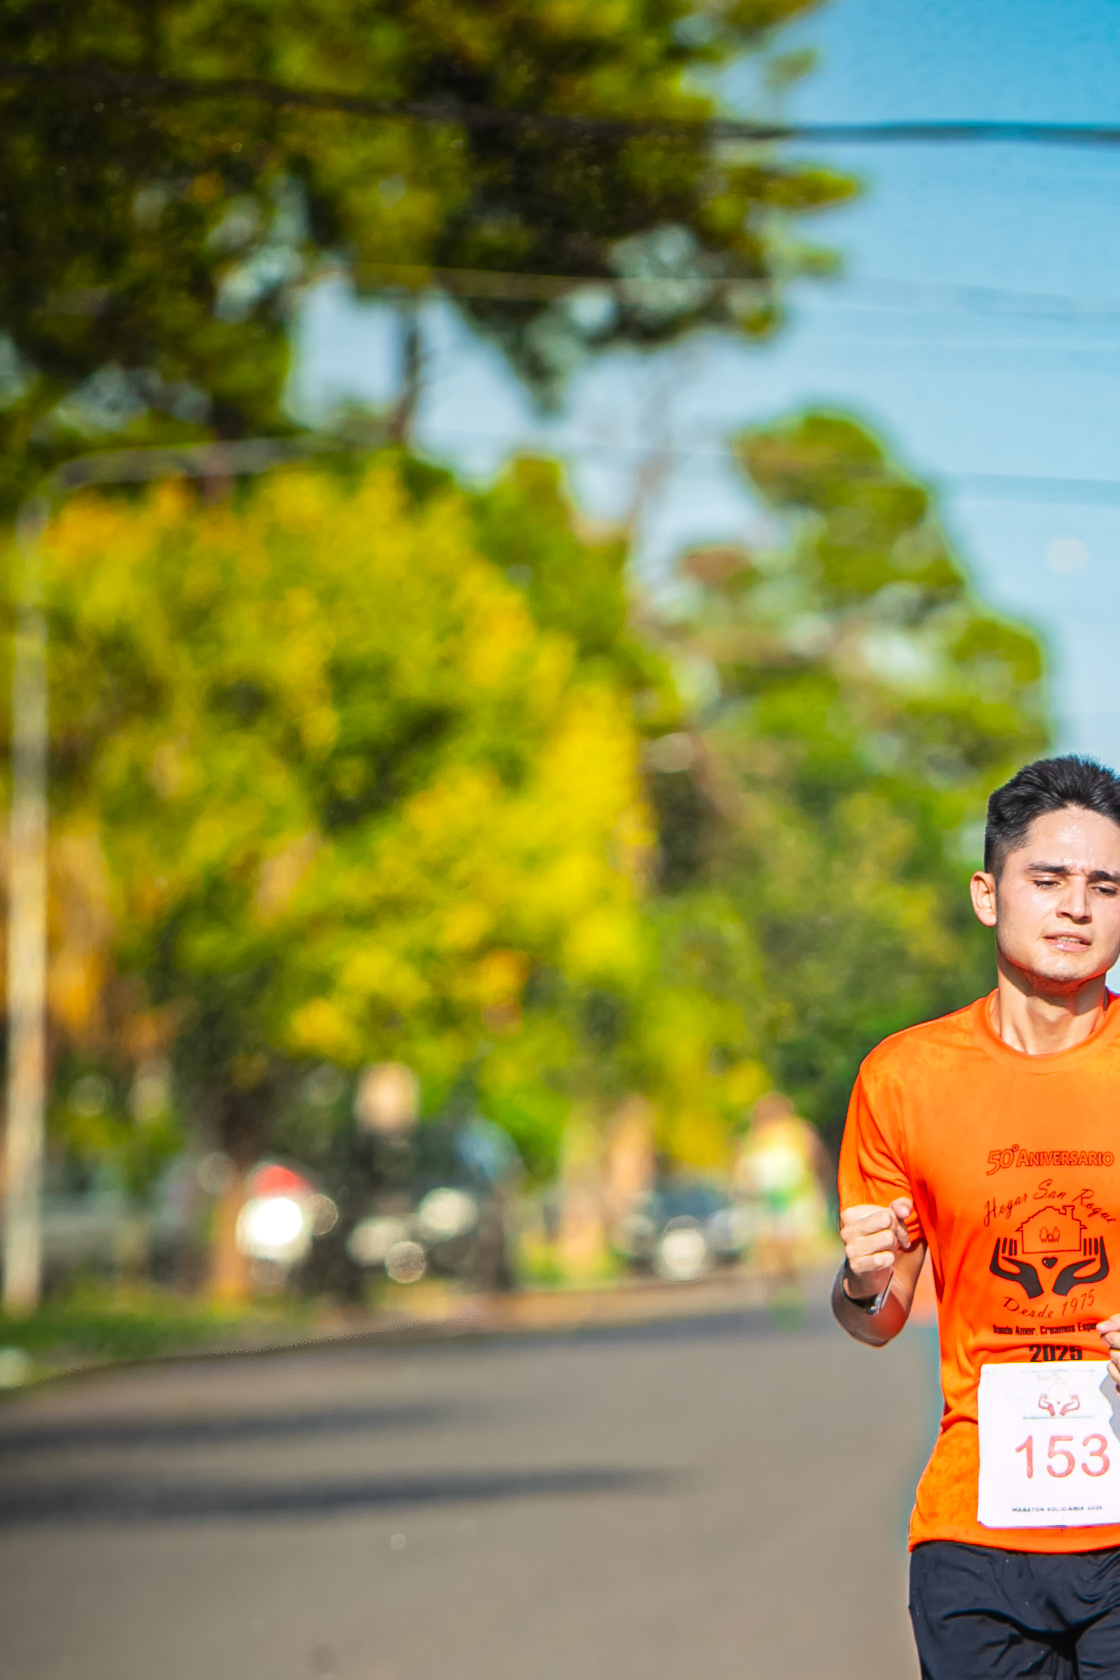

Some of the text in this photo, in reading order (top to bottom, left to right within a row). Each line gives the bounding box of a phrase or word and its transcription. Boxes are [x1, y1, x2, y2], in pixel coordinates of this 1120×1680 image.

[1015, 1149, 1115, 1168] ANIVERSARIO
[984, 1178, 1117, 1227] Hogar San Roque
[1003, 1288, 1095, 1319] Desde 1975
[1039, 1323, 1076, 1335] Creamos
[1028, 1344, 1083, 1362] 2025
[1015, 1433, 1111, 1479] 153
